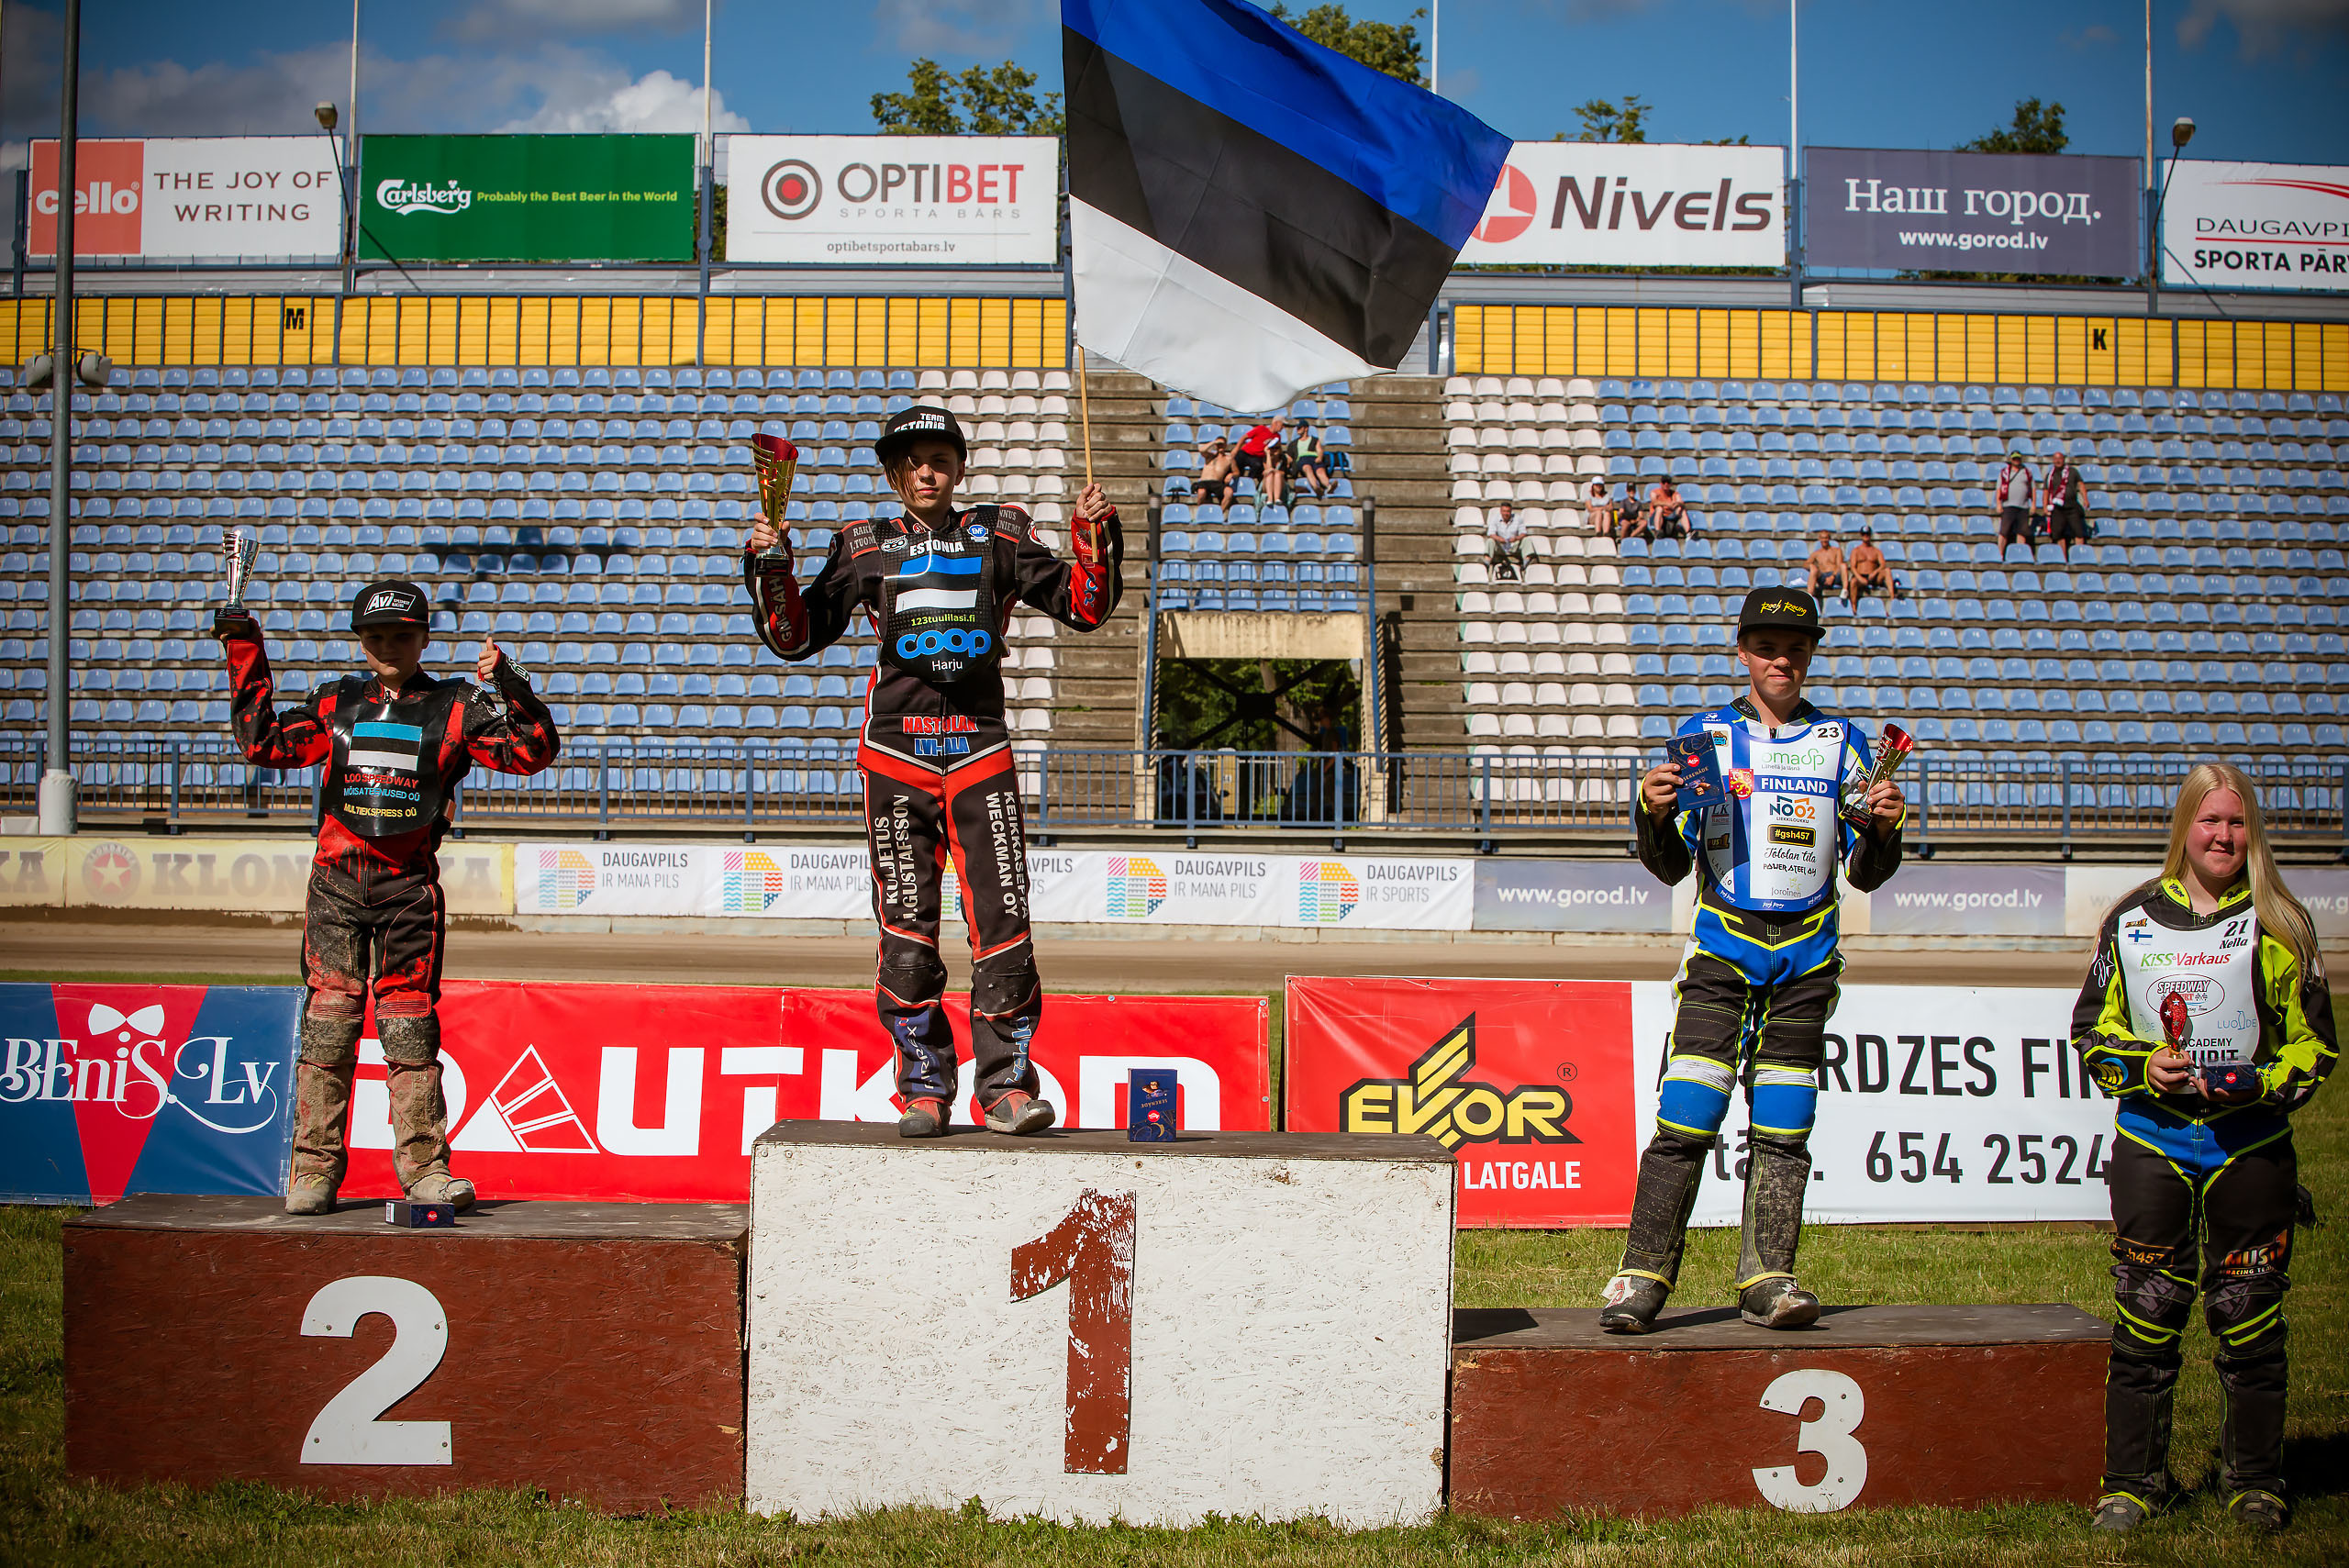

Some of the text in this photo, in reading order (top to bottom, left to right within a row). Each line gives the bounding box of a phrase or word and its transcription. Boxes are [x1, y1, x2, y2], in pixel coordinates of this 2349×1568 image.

[153, 171, 332, 190] THE JOY OF
[837, 162, 1024, 204] OPTIBET
[376, 179, 472, 216] Carlsberg
[477, 191, 678, 204] Probably the Best Beer in the World
[1551, 176, 1773, 231] Nivels
[1844, 178, 2101, 226] Наш город.
[174, 203, 310, 222] WRITING
[840, 207, 938, 219] SPORTA
[827, 239, 956, 254] optibetsportabars.lv
[1898, 231, 2049, 250] www.gorod.lv
[2194, 249, 2291, 272] SPORTA
[284, 307, 305, 330] M
[2092, 328, 2108, 351] K
[920, 413, 944, 422] TEAM
[909, 539, 965, 557] ESTONIA
[911, 613, 975, 627] 123tuulilasi.fi
[896, 628, 992, 660] coop
[931, 659, 963, 673] Harju
[1817, 727, 1840, 739] 23
[1761, 777, 1828, 795] FINLAND
[1774, 828, 1810, 840] #gsh457
[602, 852, 689, 868] DAUGAVPILS
[790, 854, 871, 870] DAUGAVPIL
[874, 816, 899, 906] KULJETUS
[893, 794, 919, 923] J.GUSTAFSSON
[985, 791, 1019, 917] WECKMAN OY
[1174, 860, 1266, 877] DAUGAVPILS
[1366, 864, 1457, 882] DAUGAVPILS
[602, 873, 679, 889] IR MANA PILS
[790, 876, 871, 891] IR MANA PILS
[1174, 883, 1256, 899] IR MANA PILS
[1366, 887, 1430, 903] IR SPORTS
[1497, 885, 1649, 907] www.gorod.lv
[1894, 889, 2043, 911] www.gorod.lv
[2224, 918, 2249, 938] 21
[2219, 937, 2249, 950] Nella
[2141, 951, 2232, 968] KiSS Varkaus
[2156, 980, 2210, 995] SPEEDWAY
[2181, 1038, 2232, 1047] ACADEMY
[1865, 1130, 1964, 1184] 654
[1464, 1161, 1581, 1191] LATGALE
[1010, 1188, 1136, 1474] 1
[300, 1275, 452, 1465] 2
[1752, 1368, 1868, 1514] 3
